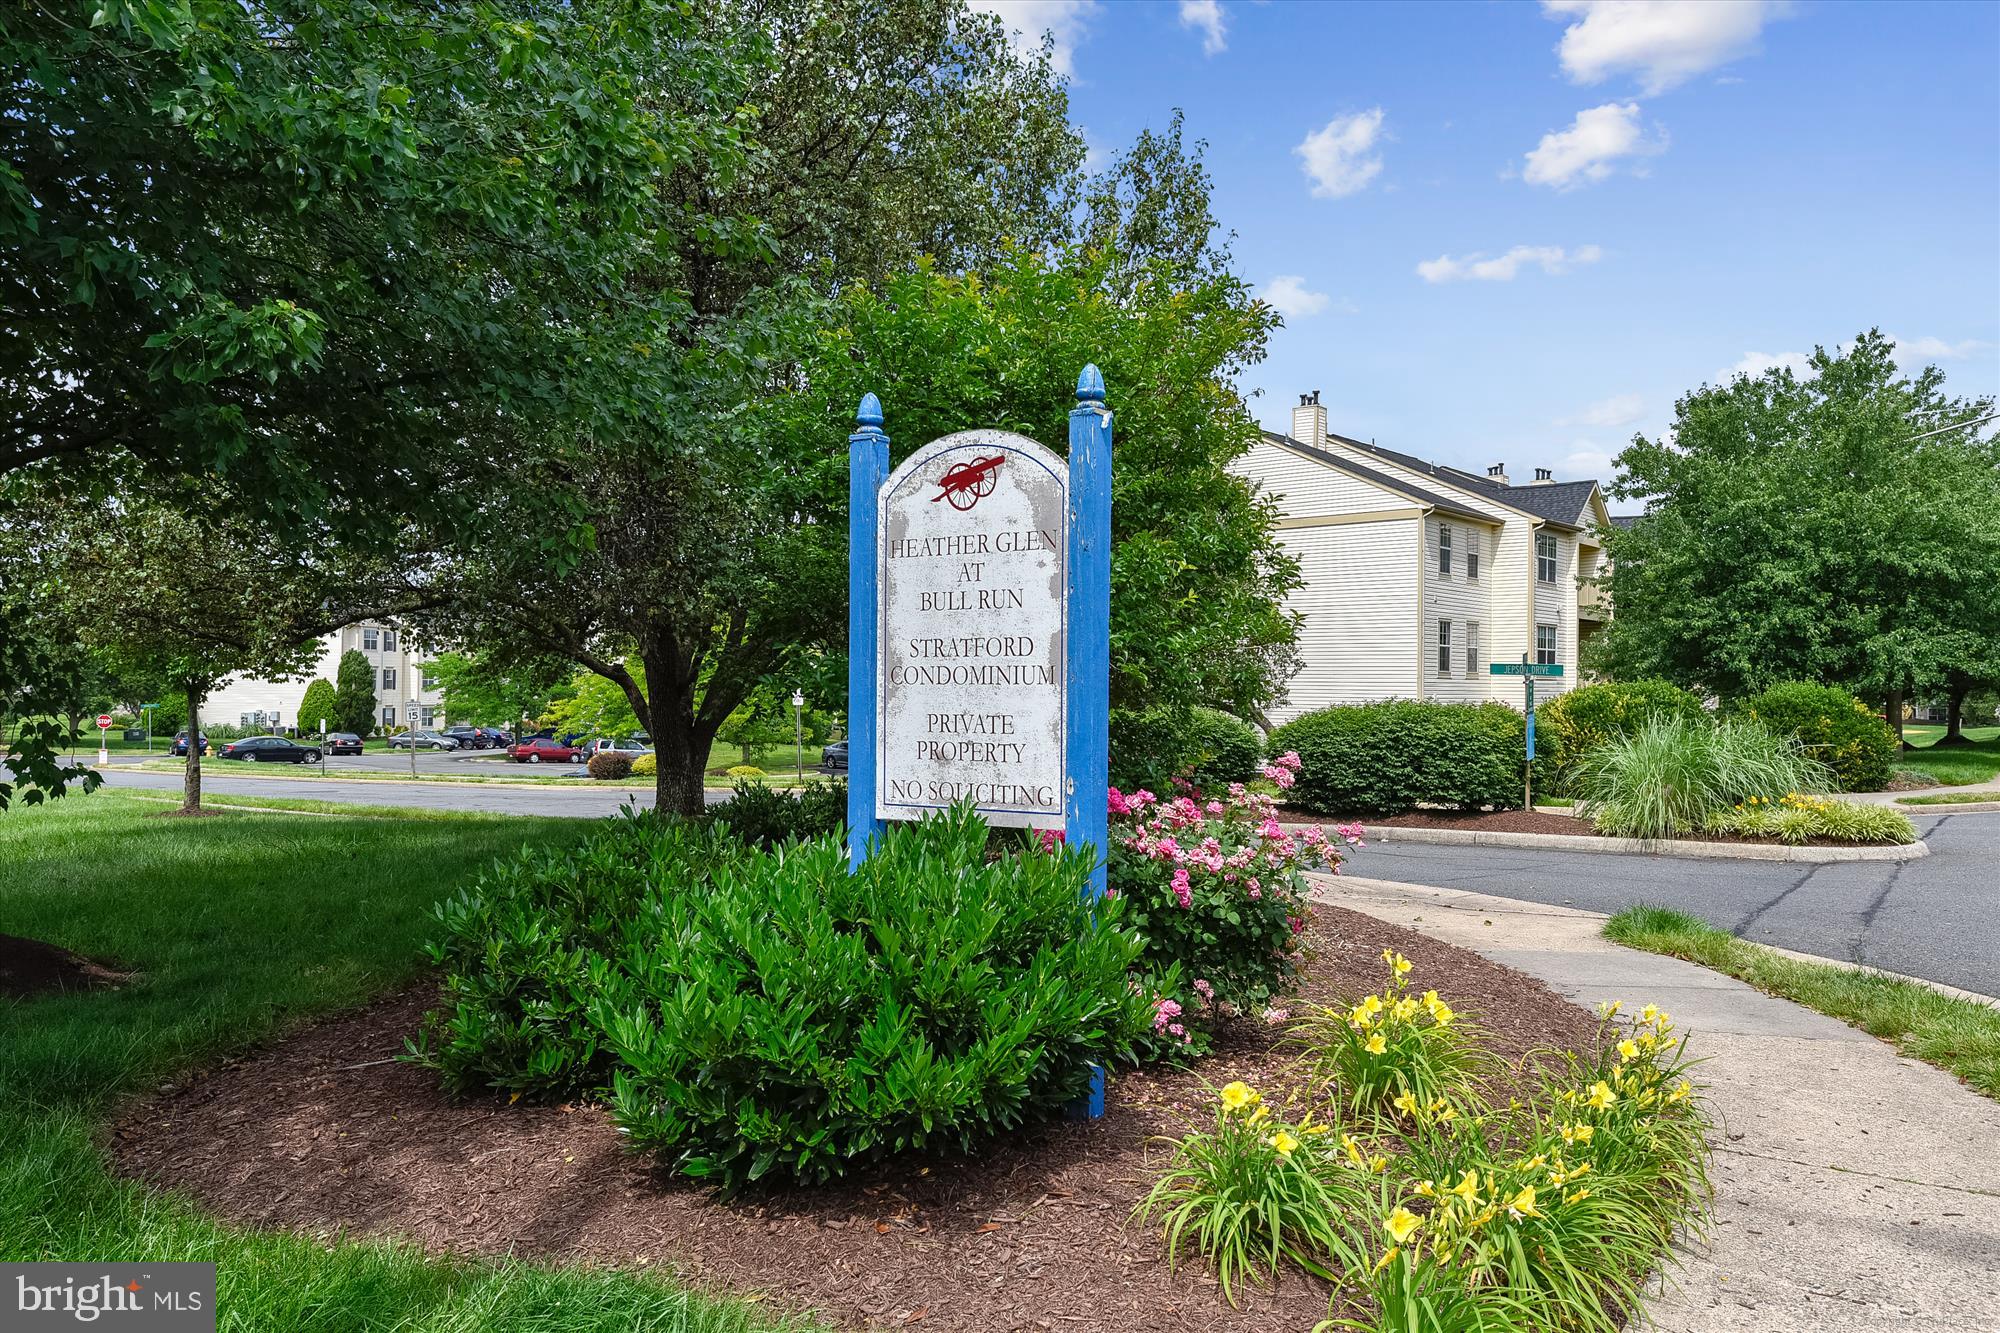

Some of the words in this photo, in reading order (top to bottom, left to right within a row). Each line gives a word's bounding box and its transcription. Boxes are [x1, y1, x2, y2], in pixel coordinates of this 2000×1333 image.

[890, 534, 989, 559] HEATHER
[995, 529, 1058, 552] GLEN
[957, 562, 985, 583] AT
[920, 590, 972, 612] BULL
[978, 588, 1024, 609] RUN
[909, 635, 1034, 659] STRATFORD
[890, 664, 1055, 686] CONDOMINIUM
[1503, 664, 1529, 674] JEPSON
[1531, 665, 1550, 675] DRIVE
[408, 711, 418, 720] 15
[927, 713, 1015, 736] PRIVATE
[916, 740, 1027, 764] PROPERTY
[890, 779, 922, 800] NO
[928, 780, 1054, 807] SOLICITING
